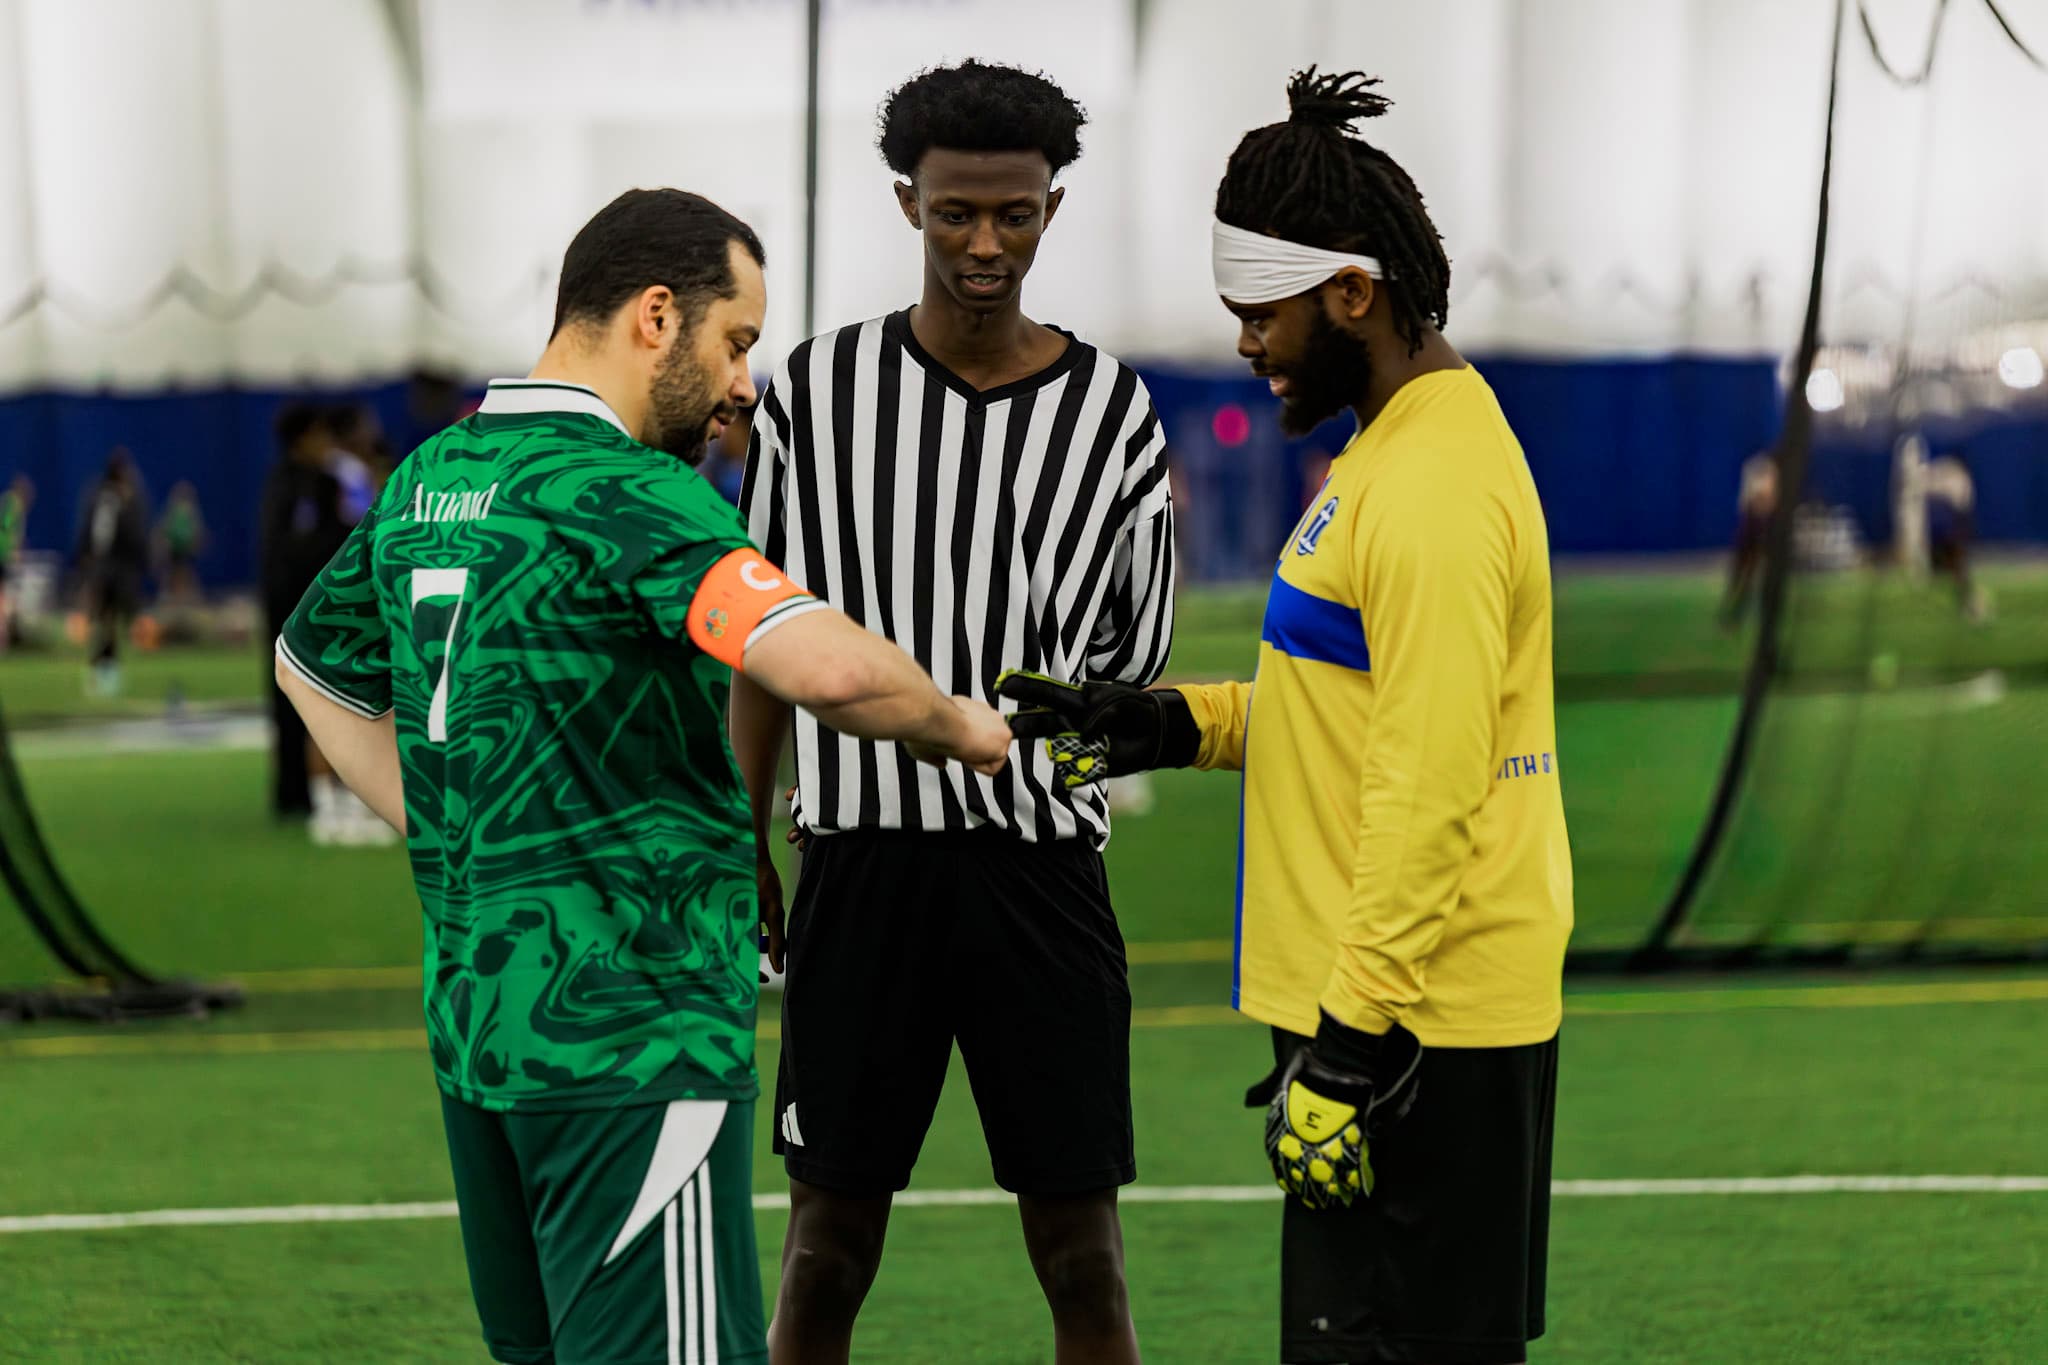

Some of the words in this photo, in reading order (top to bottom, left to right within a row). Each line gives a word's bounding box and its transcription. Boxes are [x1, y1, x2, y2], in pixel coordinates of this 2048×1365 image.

[401, 482, 499, 523] Arnaud
[739, 560, 782, 591] C
[411, 567, 469, 742] 7
[1496, 753, 1538, 781] ITH
